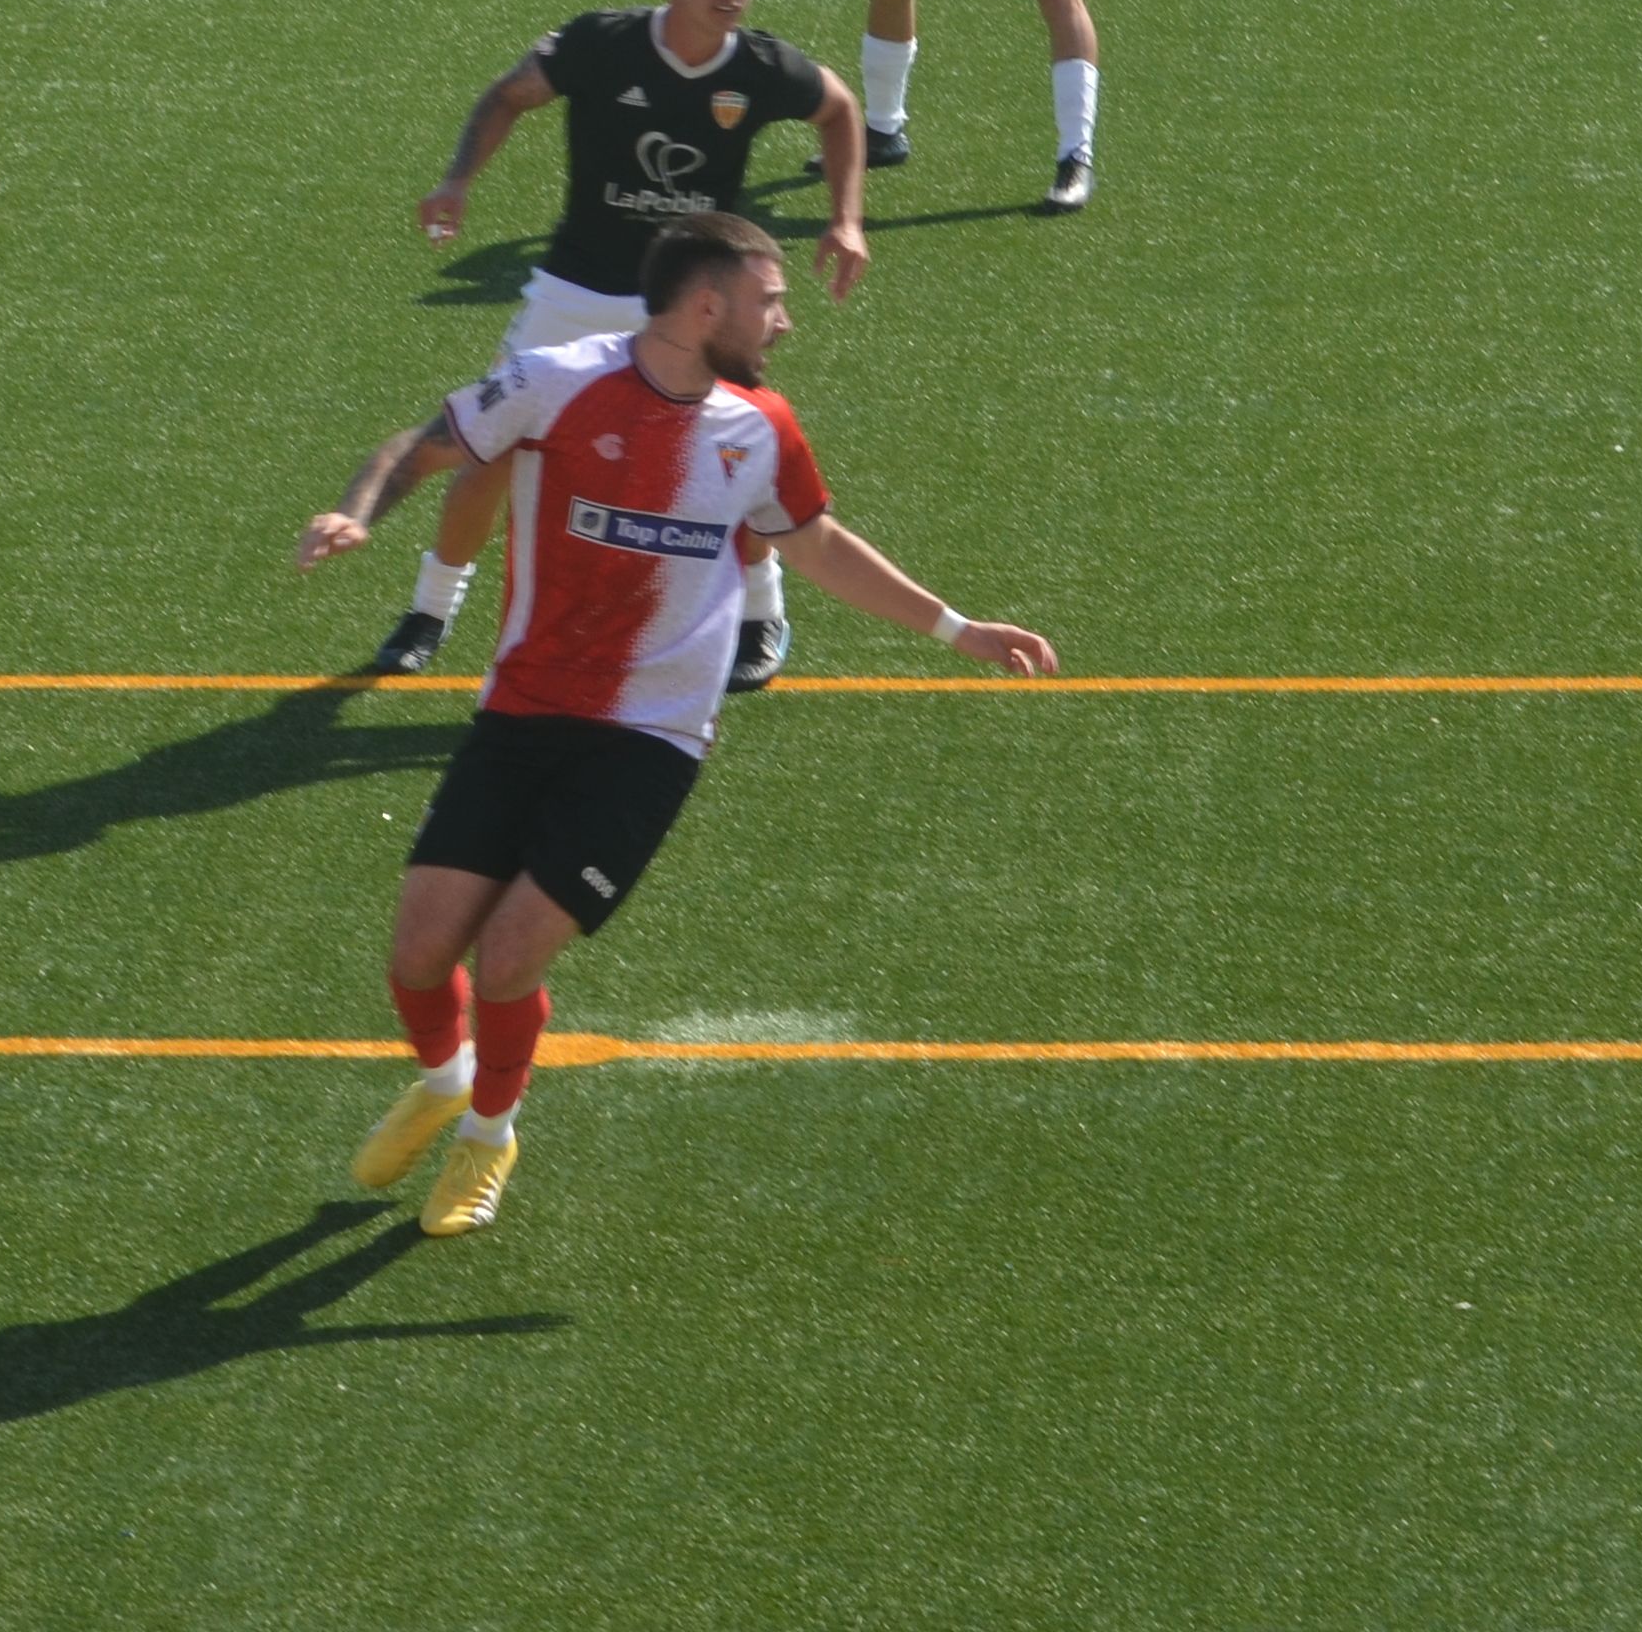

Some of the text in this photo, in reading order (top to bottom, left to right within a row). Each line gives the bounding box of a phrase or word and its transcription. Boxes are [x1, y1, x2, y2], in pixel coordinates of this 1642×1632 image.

[603, 181, 716, 214] LaPobla
[615, 517, 723, 551] Top Cable
